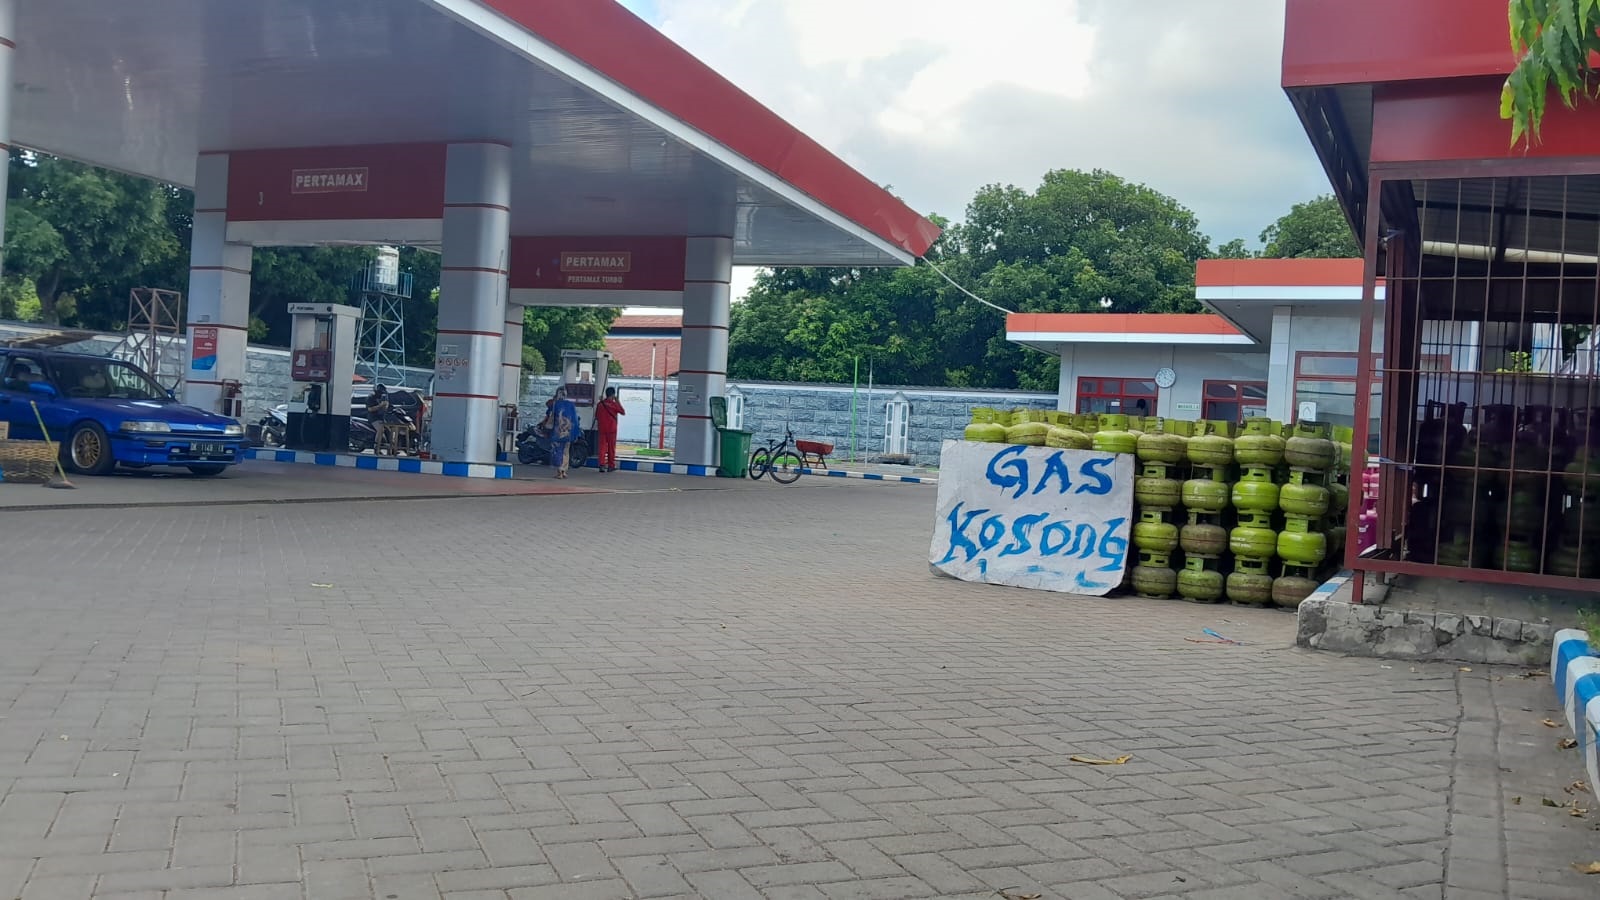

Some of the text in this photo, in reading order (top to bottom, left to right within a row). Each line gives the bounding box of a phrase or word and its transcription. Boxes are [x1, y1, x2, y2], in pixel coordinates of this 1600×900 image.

[295, 173, 364, 188] PERTAMAX
[566, 256, 625, 268] PERTAMAX
[985, 445, 1115, 499] GAS
